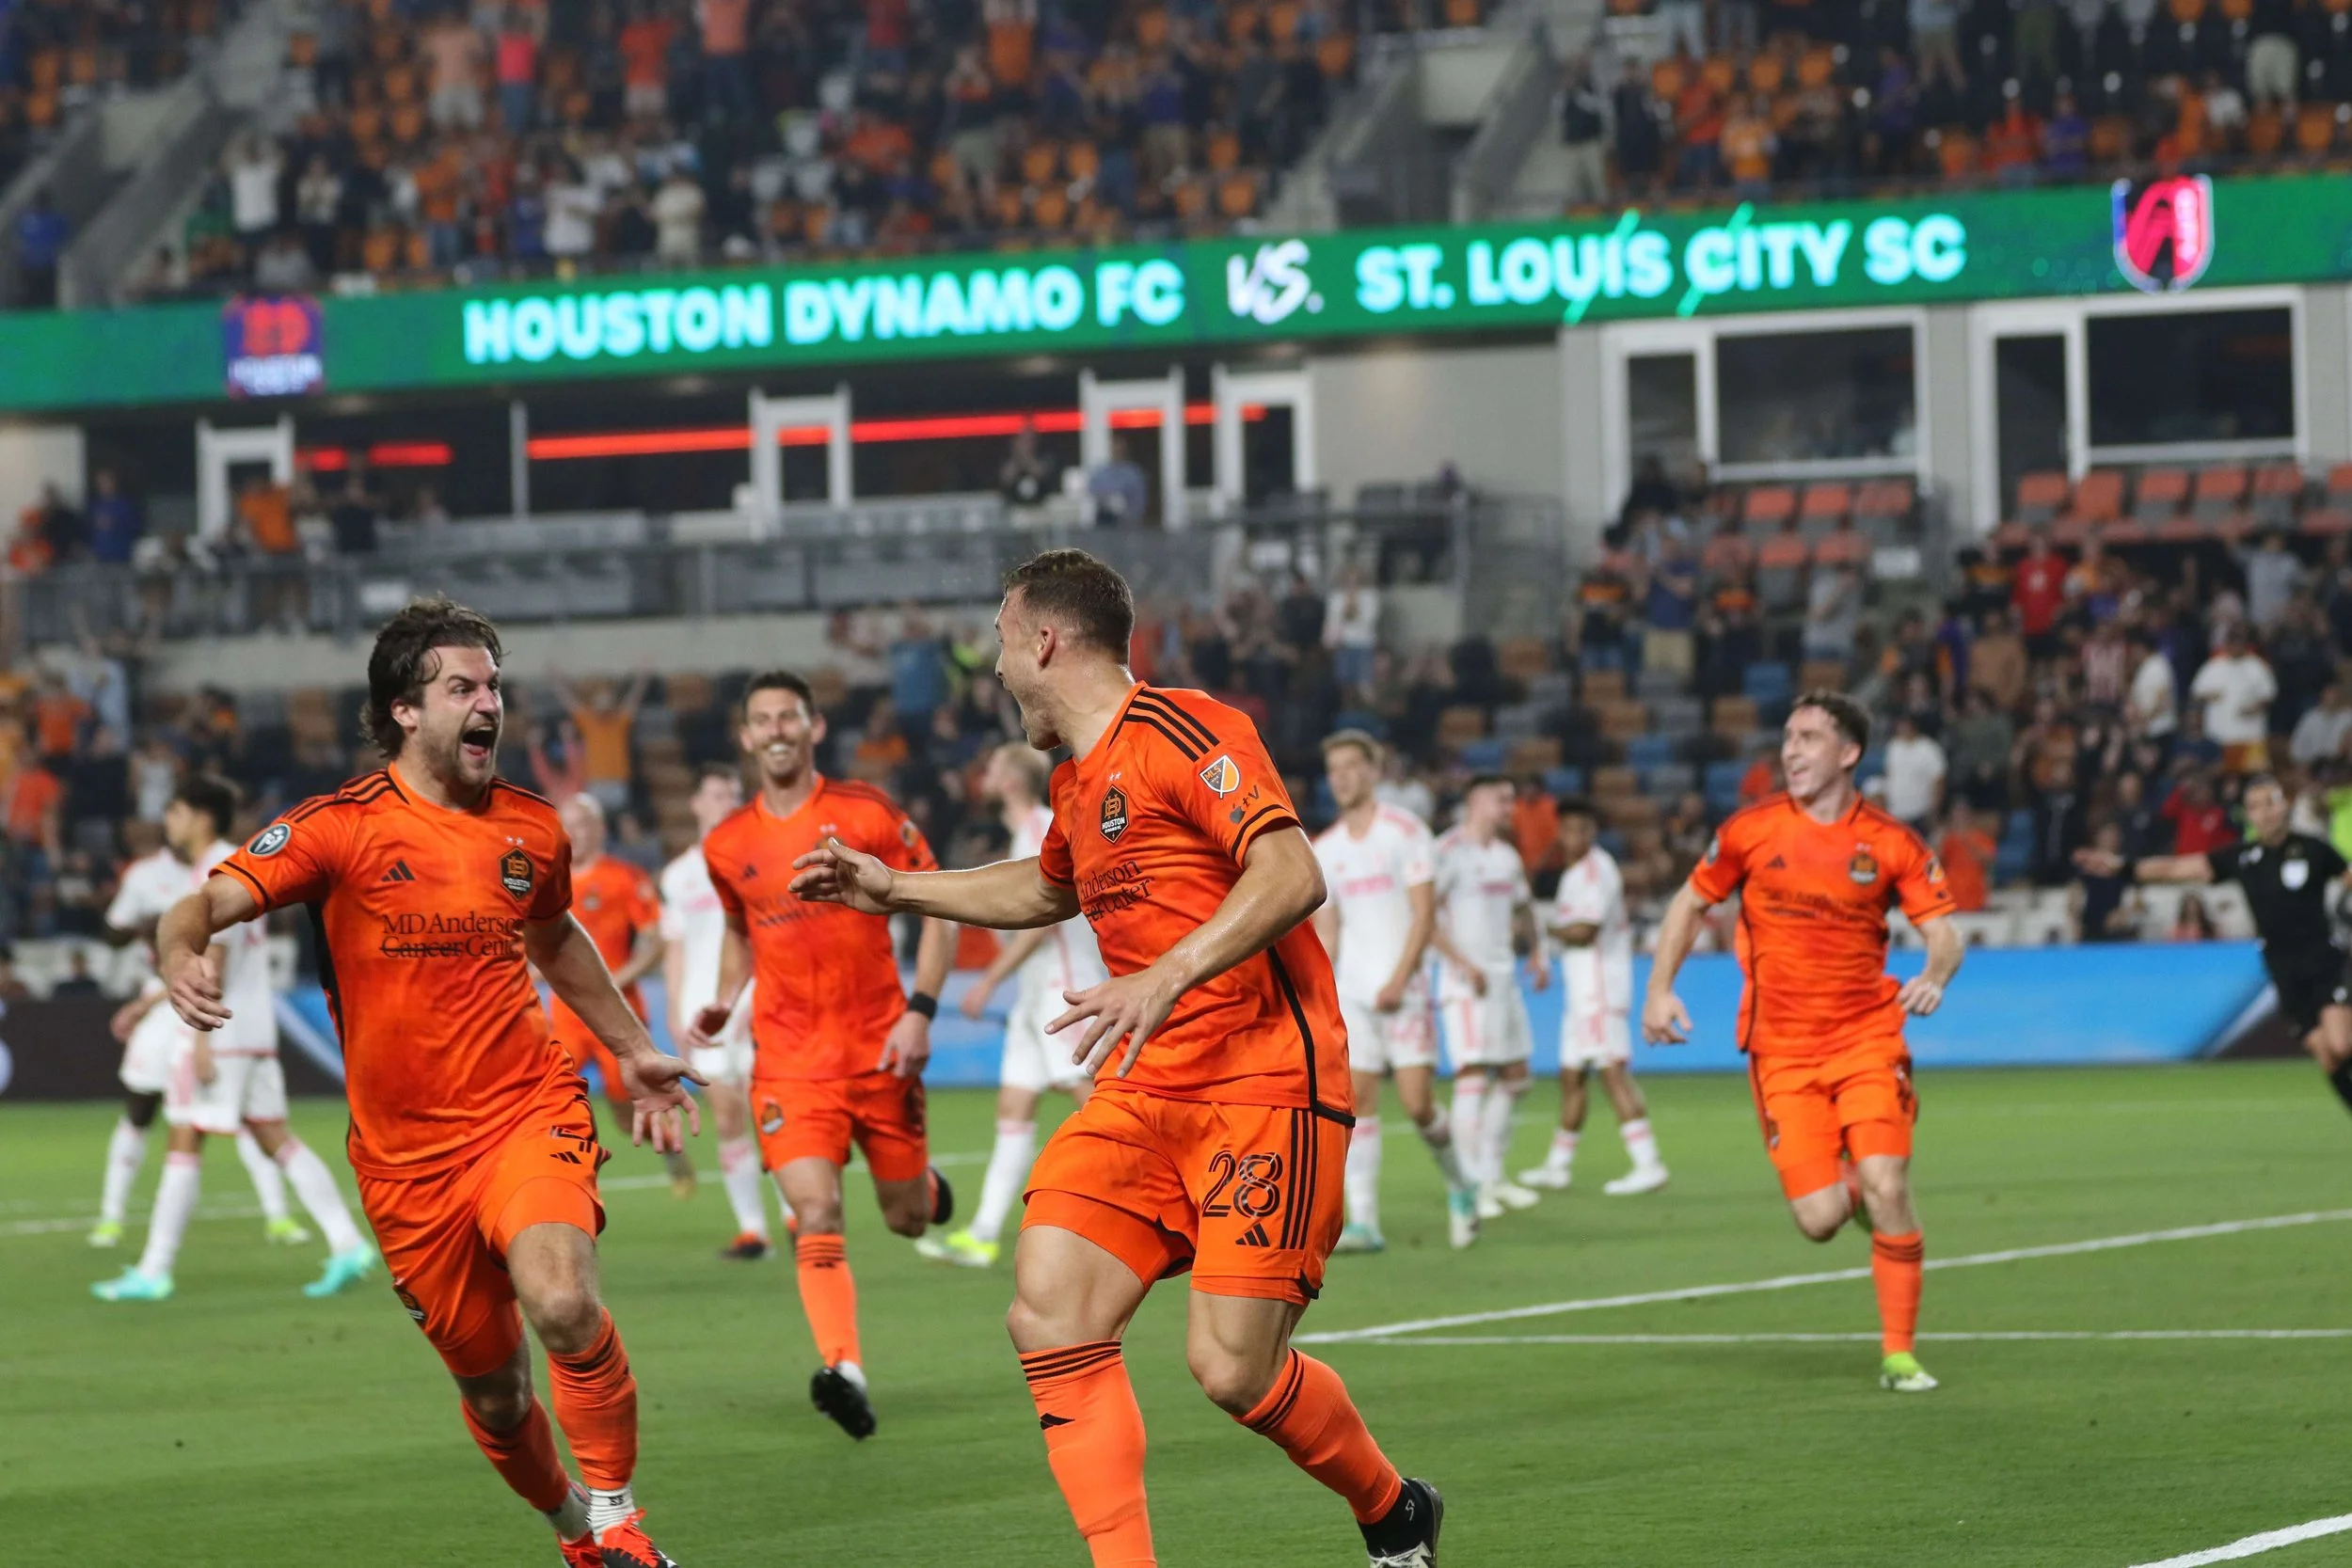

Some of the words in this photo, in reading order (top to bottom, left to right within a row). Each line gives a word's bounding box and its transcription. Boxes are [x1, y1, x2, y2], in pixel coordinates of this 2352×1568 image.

[1356, 244, 1454, 313] ST.
[1681, 207, 1851, 312] CITY
[1864, 214, 1966, 284] SC
[463, 285, 773, 364] HOUSTON
[784, 265, 1084, 345] DYNAMO
[1095, 259, 1184, 327] FC
[1204, 765, 1222, 781] MLS
[1102, 816, 1125, 831] HOUSTON
[382, 913, 426, 935] MD
[428, 911, 518, 938] Anderso
[380, 935, 463, 958] Cancer
[466, 935, 516, 957] Cent
[1201, 1149, 1283, 1219] 28
